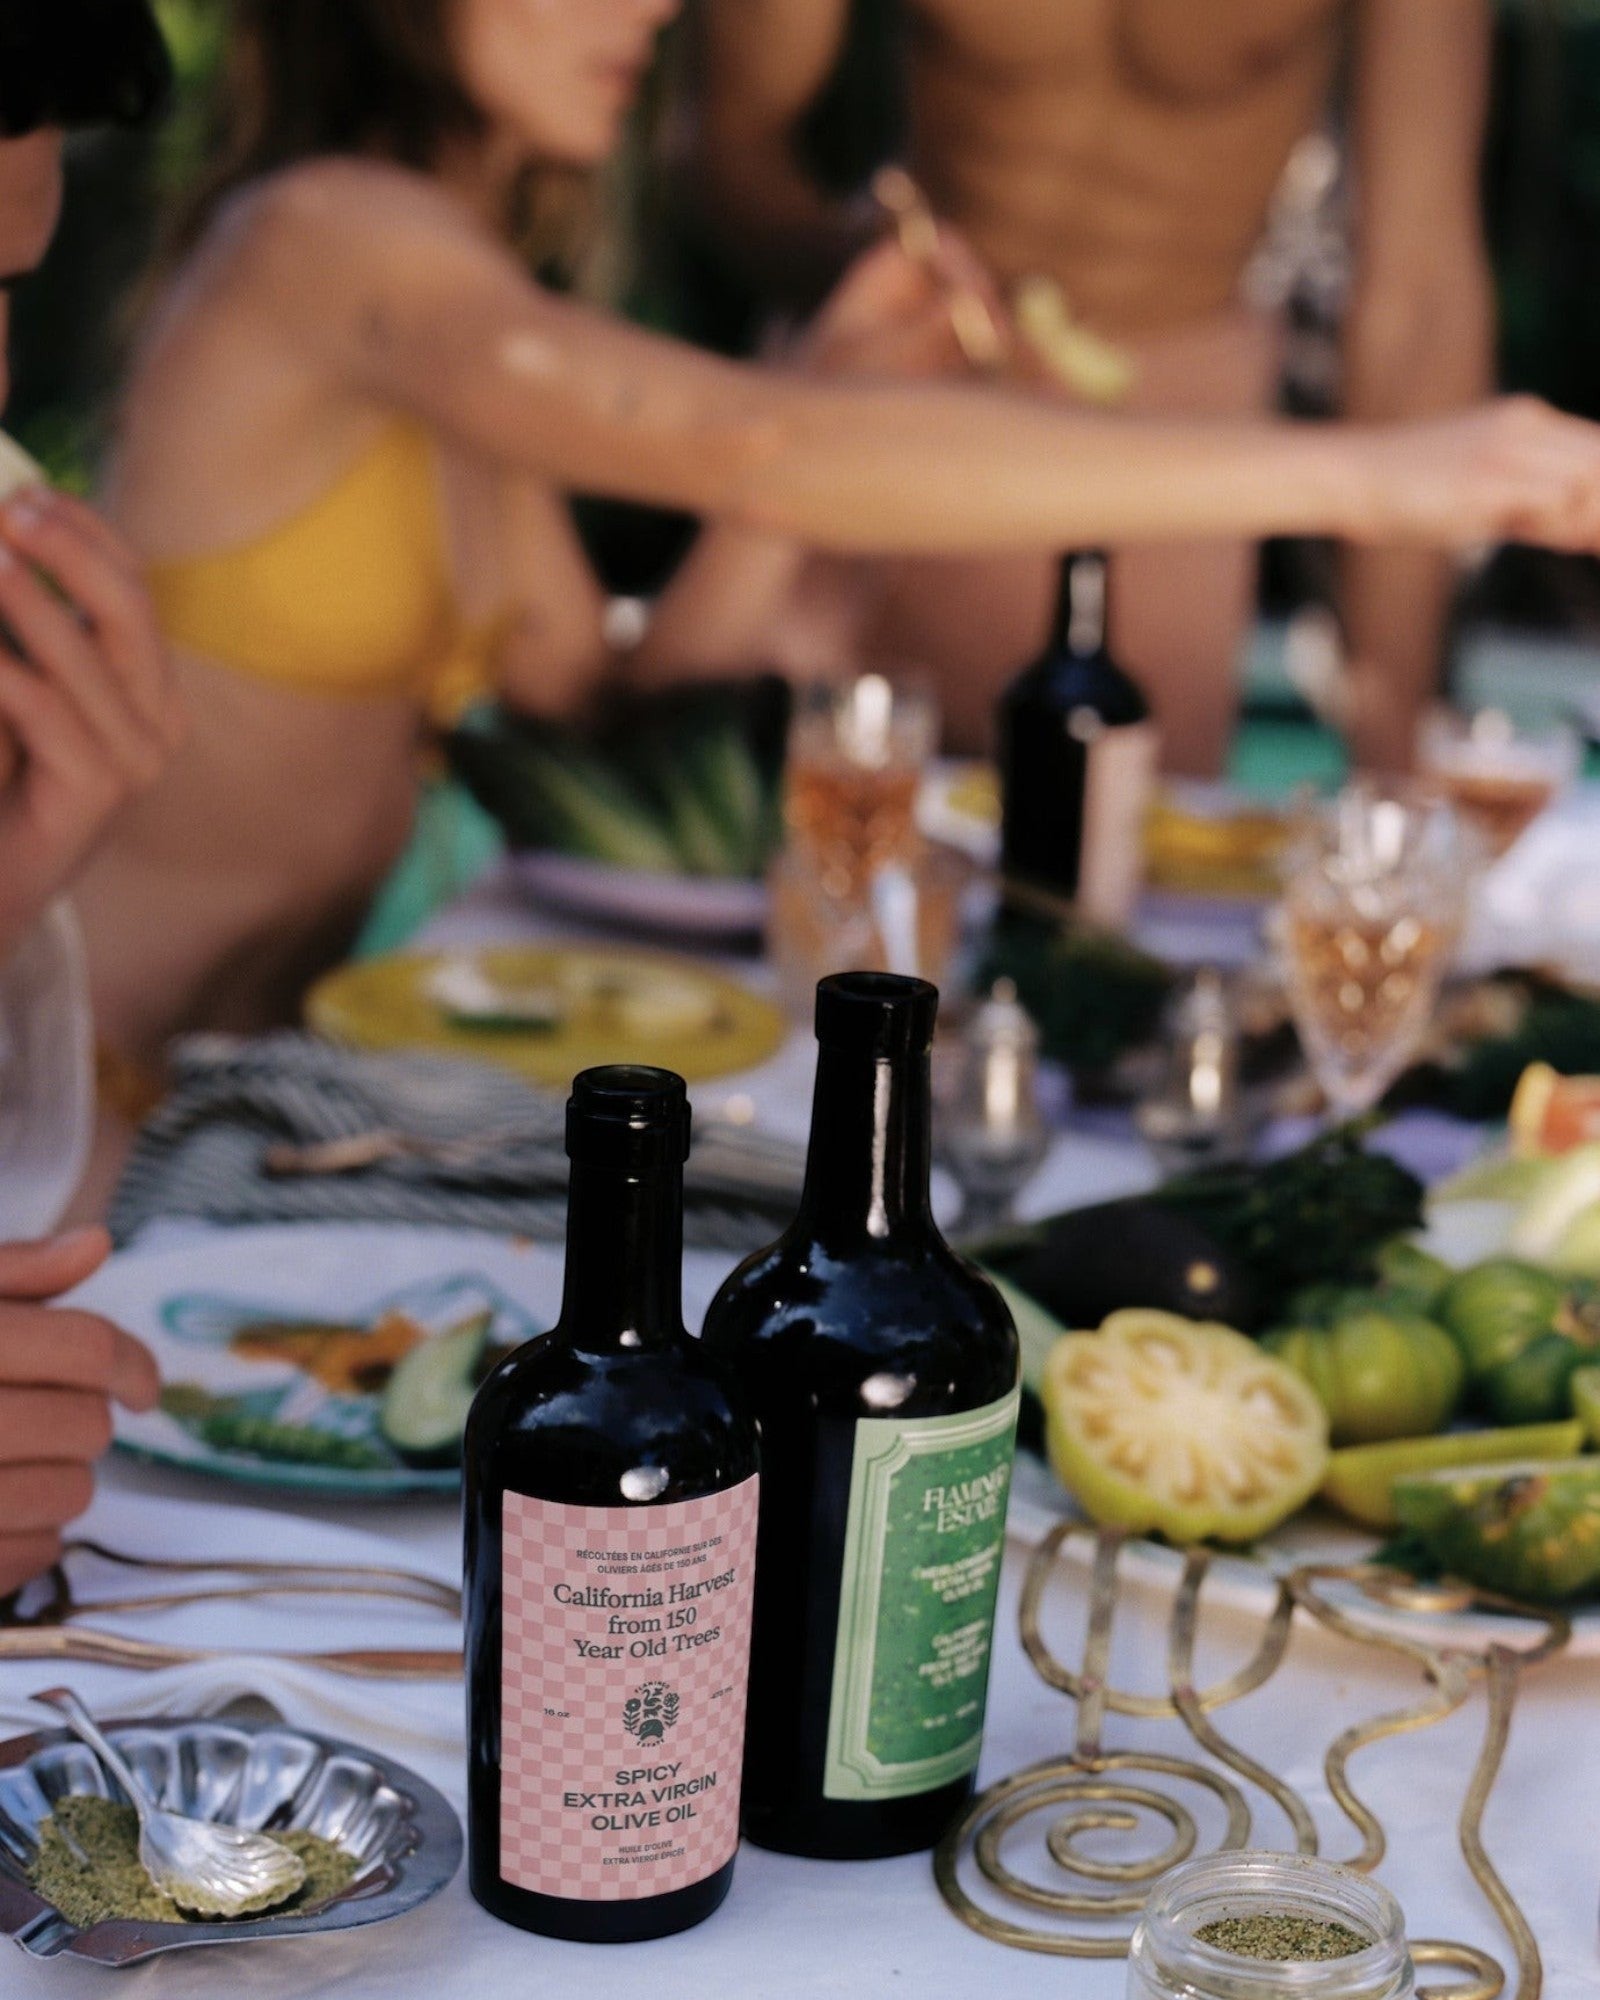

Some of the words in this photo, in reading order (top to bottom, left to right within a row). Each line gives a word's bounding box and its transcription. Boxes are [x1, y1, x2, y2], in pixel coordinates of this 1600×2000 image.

[576, 1549, 628, 1561] RÉCOLTÉES
[630, 1551, 642, 1561] EN
[644, 1546, 691, 1560] CALIFORNIE
[692, 1541, 708, 1552] SUR
[709, 1536, 722, 1547] DES
[597, 1565, 638, 1575] OLIVIERS
[663, 1561, 675, 1571] DE
[676, 1558, 691, 1568] 150
[691, 1554, 707, 1566] ANS
[553, 1584, 663, 1609] California
[668, 1566, 735, 1604] Harvest
[608, 1615, 661, 1634] from
[667, 1607, 697, 1631] 150
[573, 1639, 623, 1659] Year
[630, 1636, 667, 1657] Old
[672, 1625, 721, 1652] Trees
[615, 1762, 682, 1786] SPICY
[564, 1792, 646, 1808] EXTRA
[651, 1771, 717, 1803] VIRGIN
[591, 1810, 661, 1831] OLIVE
[667, 1804, 697, 1823] OIL
[603, 1857, 630, 1865] EXTRA
[631, 1853, 660, 1863] VIERGE
[619, 1845, 642, 1853] HUILE
[644, 1840, 673, 1851] D'OLIVE
